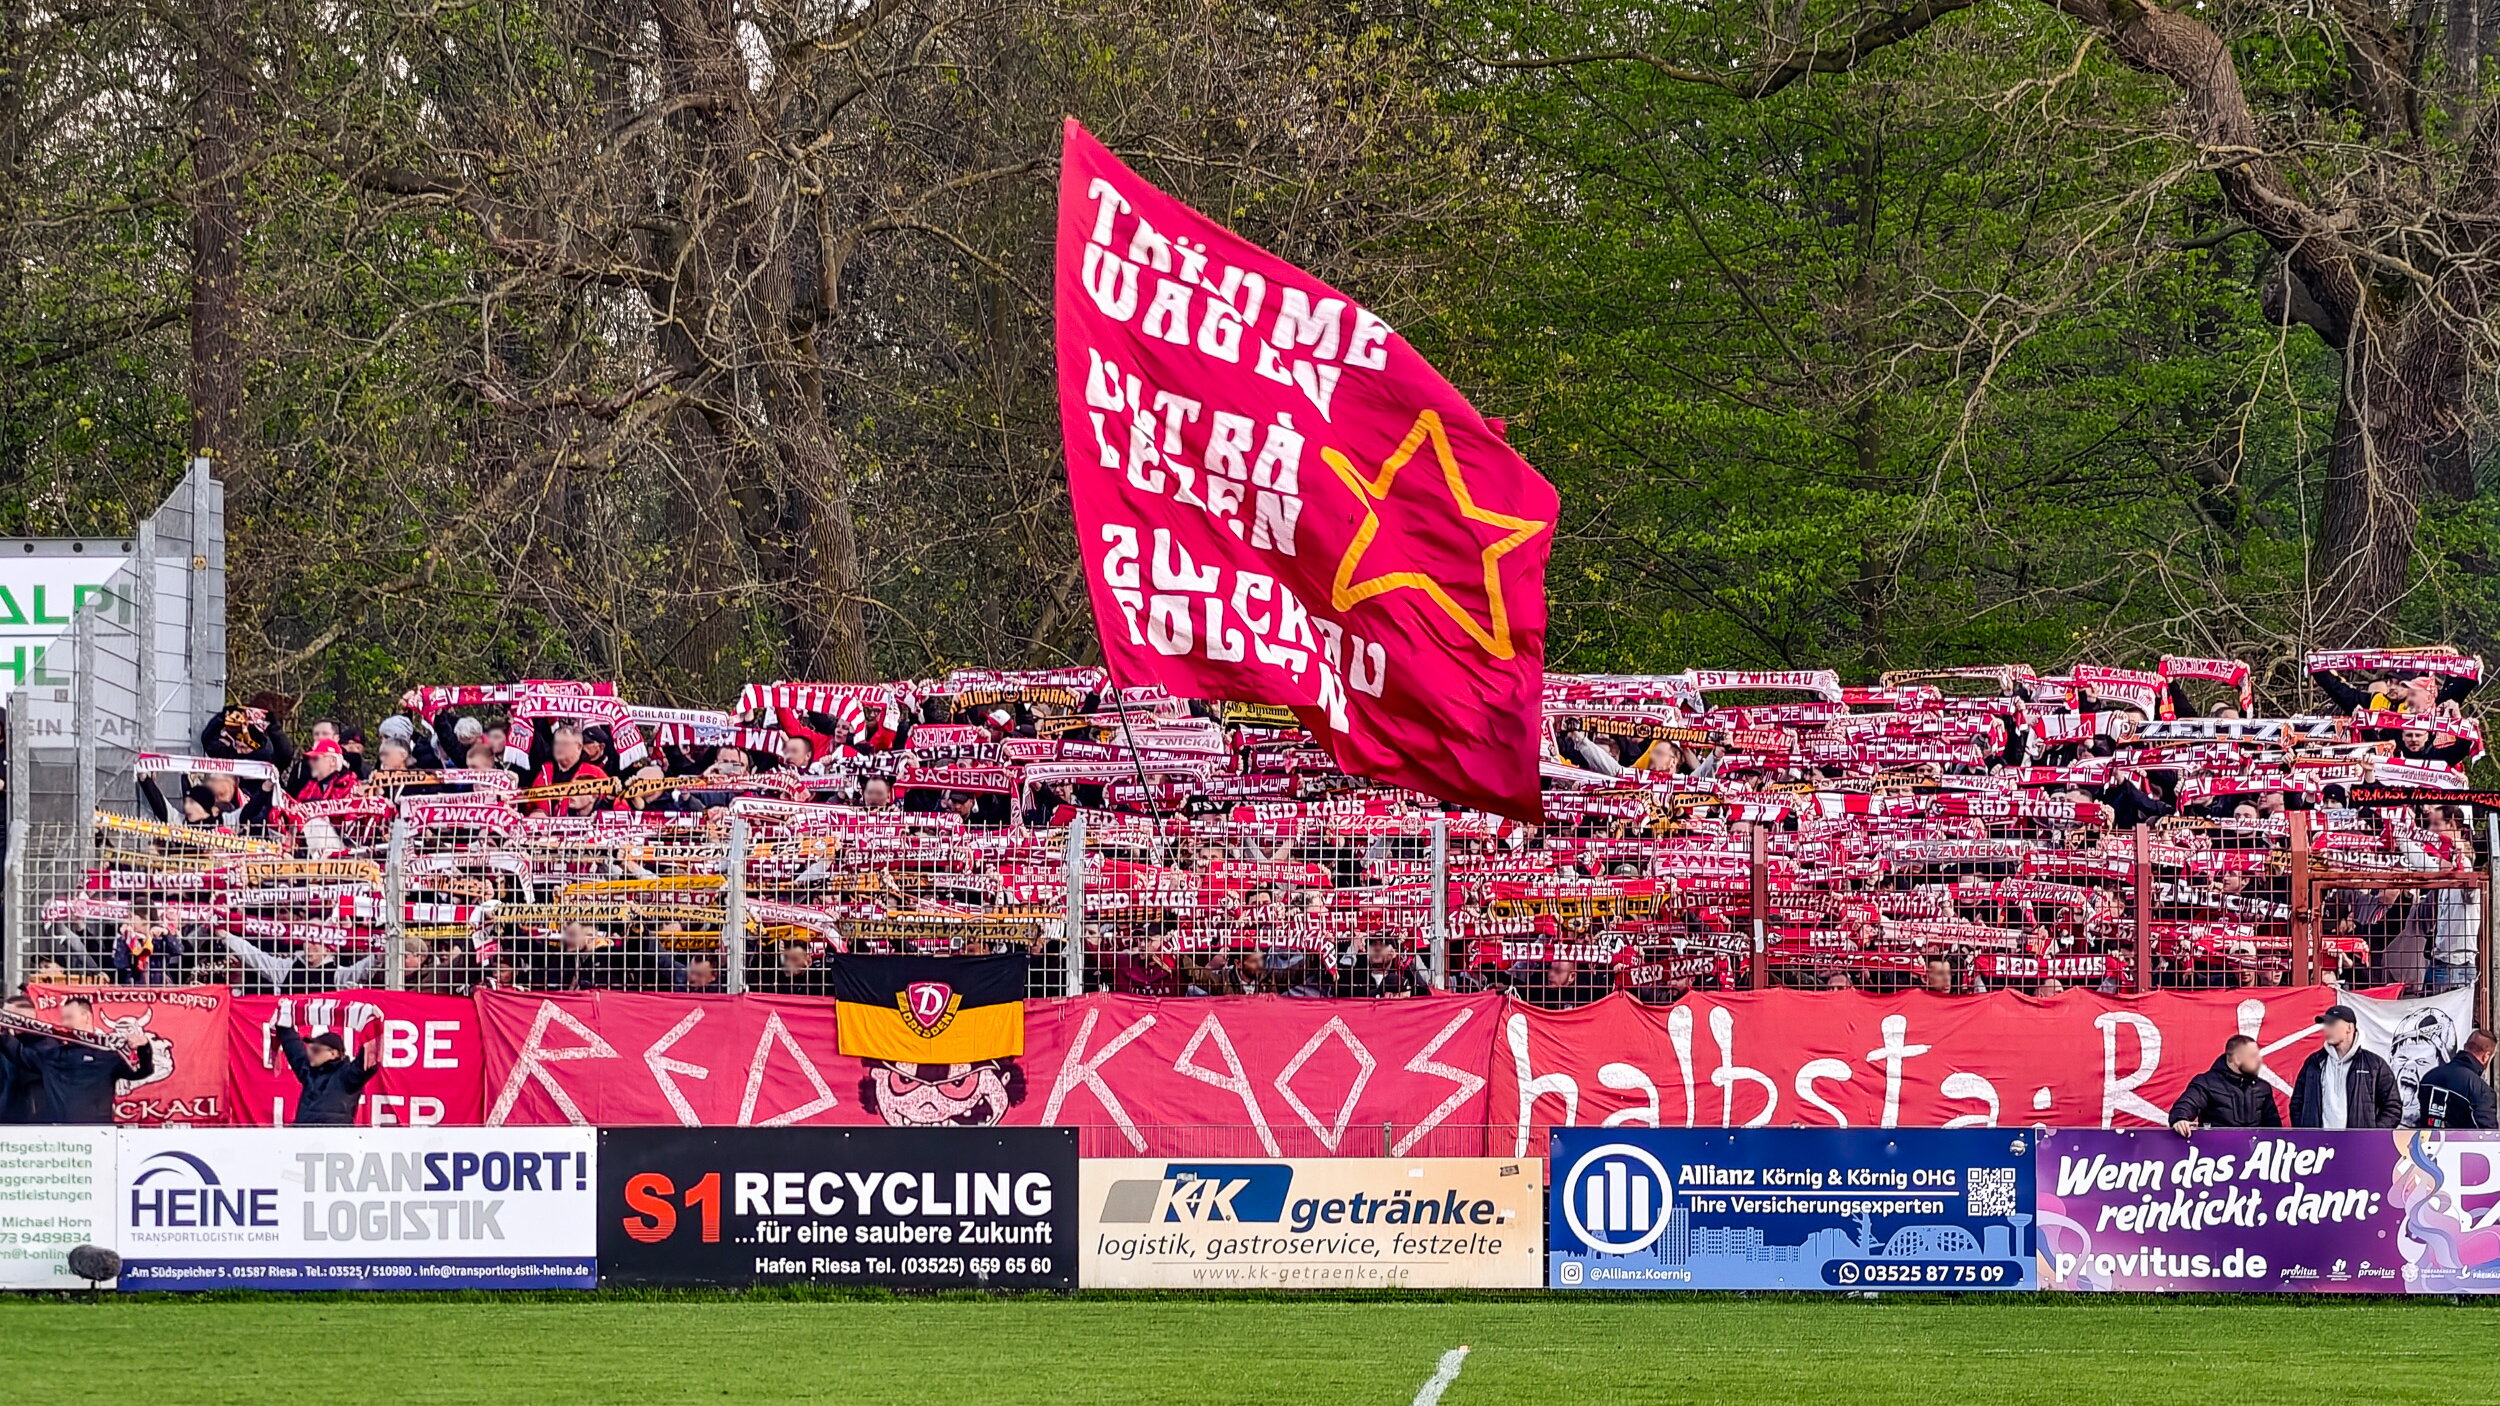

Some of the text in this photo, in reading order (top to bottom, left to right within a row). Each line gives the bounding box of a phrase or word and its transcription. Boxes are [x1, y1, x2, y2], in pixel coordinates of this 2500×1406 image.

[2310, 654, 2357, 670] GEGEN
[1697, 672, 1814, 686] FSV ZWICKAU
[547, 698, 626, 720] ZWICKAU
[680, 713, 696, 722] DIE
[700, 715, 719, 725] BSG
[1653, 727, 1708, 744] DYNAMO
[1734, 730, 1794, 749] ZWICKAU
[1847, 723, 1888, 742] FSV
[2141, 720, 2281, 741] ZEITZ
[1062, 743, 1113, 761] GEGEN
[1156, 738, 1222, 750] ZWICKAU
[1174, 778, 1291, 798] POLIZEIWILLKÜR
[1192, 802, 1225, 813] FSV
[1254, 799, 1366, 820] RED KAOS
[1885, 797, 1928, 815] FSV
[1969, 800, 2076, 819] RED KAOS
[434, 807, 514, 828] ZWICKAU
[110, 870, 205, 888] RED KAOS
[1086, 890, 1199, 910] RED KAOS
[558, 905, 621, 918] DYNAMO
[941, 925, 1018, 939] DYNAMO
[1502, 942, 1613, 964] RED KAOS
[1630, 957, 1714, 985] RED KAOS
[1995, 956, 2107, 978] RED KAOS
[902, 1011, 954, 1038] DRESDEN
[485, 999, 1488, 1157] RED KAOS
[295, 1151, 587, 1193] TRANSPORT!
[1678, 1165, 1957, 1190] Allianz Körnig & Körnig OHG
[2055, 1138, 2335, 1198] Wenn das Alter
[131, 1188, 279, 1227] HEINE
[622, 1171, 1053, 1244] S1 RECYCLING
[1290, 1188, 1506, 1233] getränke.
[1691, 1195, 1945, 1218] Ihre Versicherungsexperten
[2095, 1183, 2381, 1235] reinkickt, dann:
[2, 1216, 92, 1228] Michael Horn
[303, 1200, 506, 1242] LOGISTIK
[21, 1232, 92, 1244] 9489834
[131, 1232, 279, 1243] TRANSPORTLOGISTIK GMBH
[797, 1225, 849, 1244] eine
[854, 1222, 953, 1244] saubere
[958, 1221, 1053, 1245] Zukunft
[1097, 1232, 1503, 1261] logistik, gastroservice, festzelte
[131, 1264, 589, 1280] Am Südspeicher 5 01587 Riesa Tel.: 03525 510980 info@transportlogistik-heine.de
[755, 1257, 1053, 1277] Hafen Riesa Tel. (03525) 659 65 60
[1192, 1264, 1410, 1283] www.kk-getraenke.de
[1590, 1266, 1691, 1283] @Allianz.Koernig
[1864, 1264, 2005, 1283] 03525 87 75 09
[2054, 1246, 2268, 1287] provitus.de
[2280, 1266, 2318, 1278] provitus
[2358, 1267, 2396, 1279] provitus
